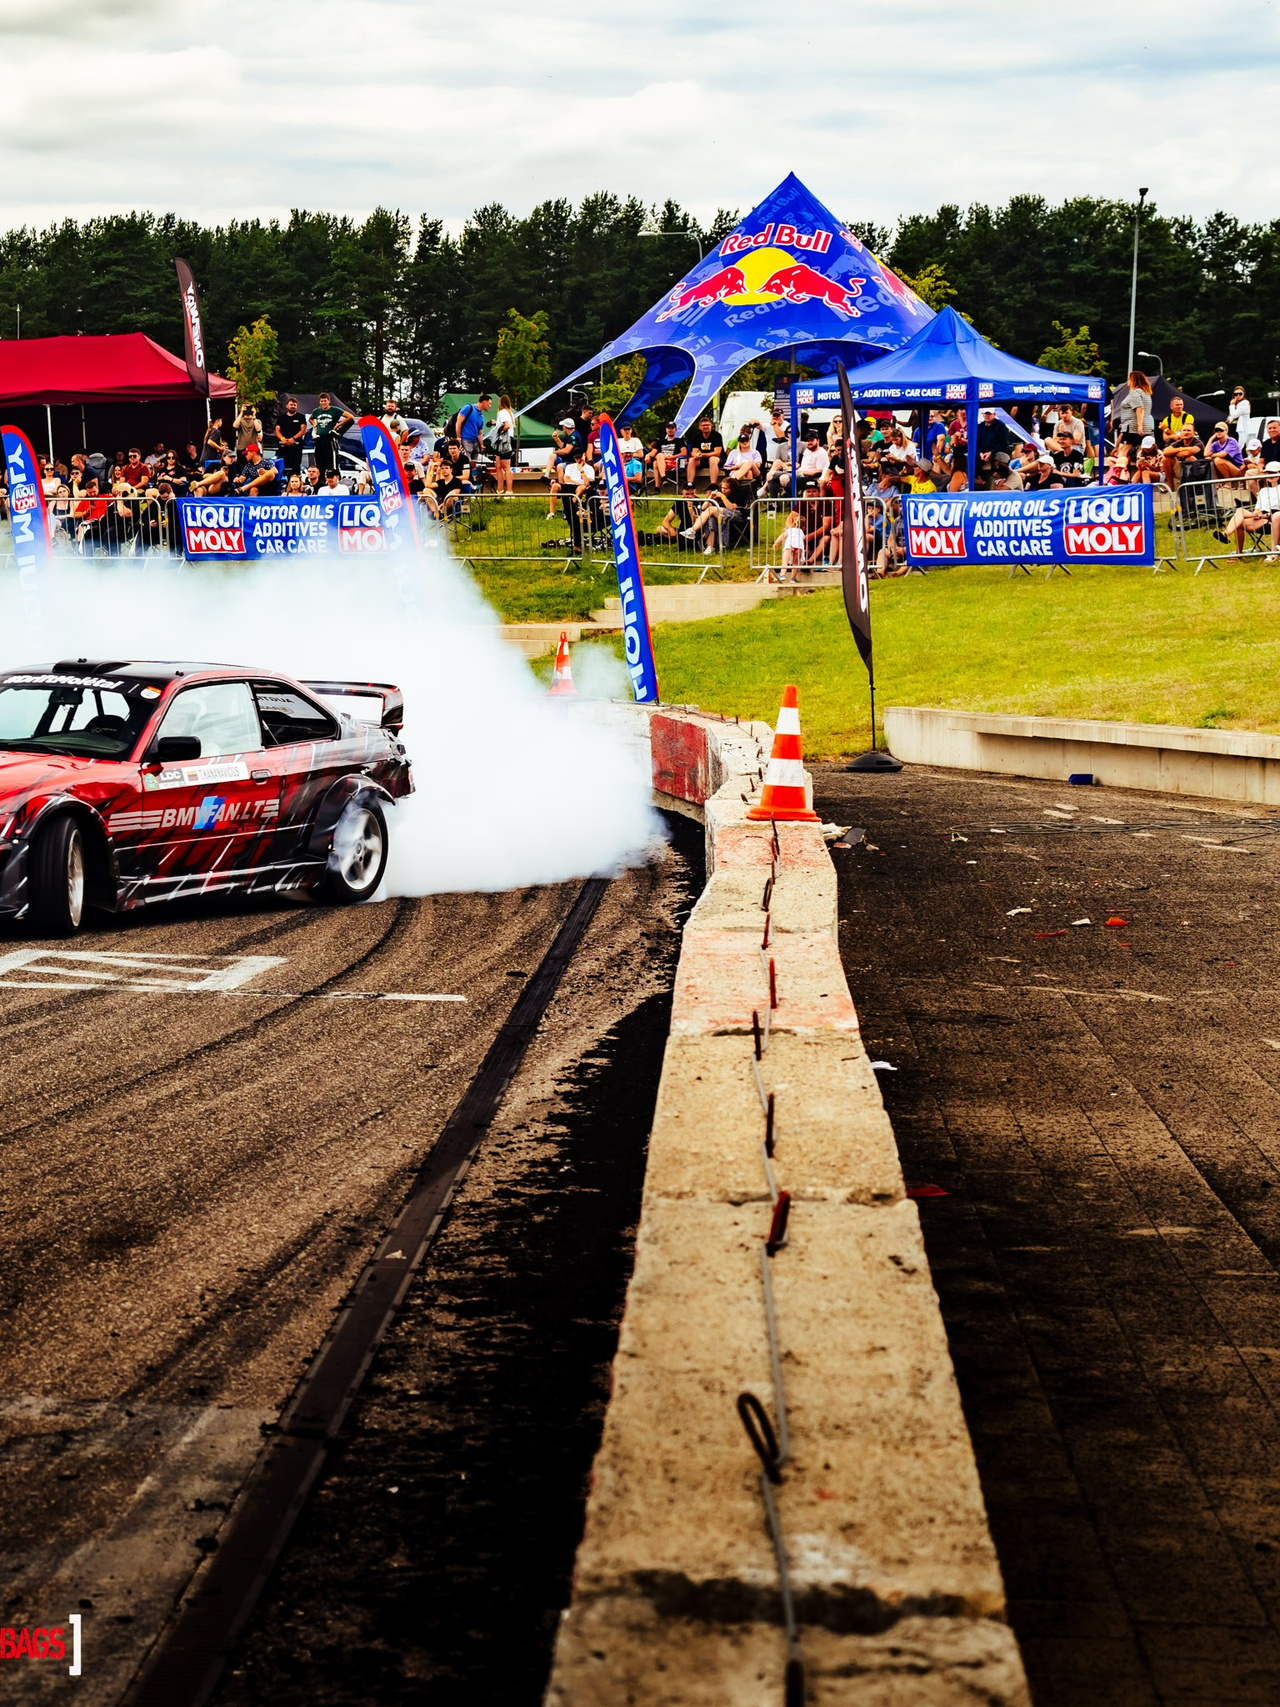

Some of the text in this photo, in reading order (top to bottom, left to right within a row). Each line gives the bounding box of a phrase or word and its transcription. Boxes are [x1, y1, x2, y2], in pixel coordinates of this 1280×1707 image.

[720, 223, 775, 256] Red
[773, 224, 833, 253] Bull
[863, 389, 901, 398] ADDITIVES
[905, 389, 920, 397] CAR
[921, 389, 942, 397] CARE
[186, 506, 241, 529] LIQUI
[248, 504, 334, 520] MOTOR OILS
[909, 502, 964, 528] LIQUI
[969, 499, 1060, 518] MOTOR OILS
[1068, 495, 1140, 525] LIQUI
[252, 521, 328, 537] ADDITIVES
[973, 519, 1053, 538] ADDITIVES
[1068, 525, 1142, 553] MOLY
[188, 529, 242, 551] MOLY
[256, 539, 328, 554] CAR CARE
[911, 530, 963, 555] MOLY
[976, 539, 1054, 557] CAR CARE
[161, 800, 267, 829] BMWFAN.LT
